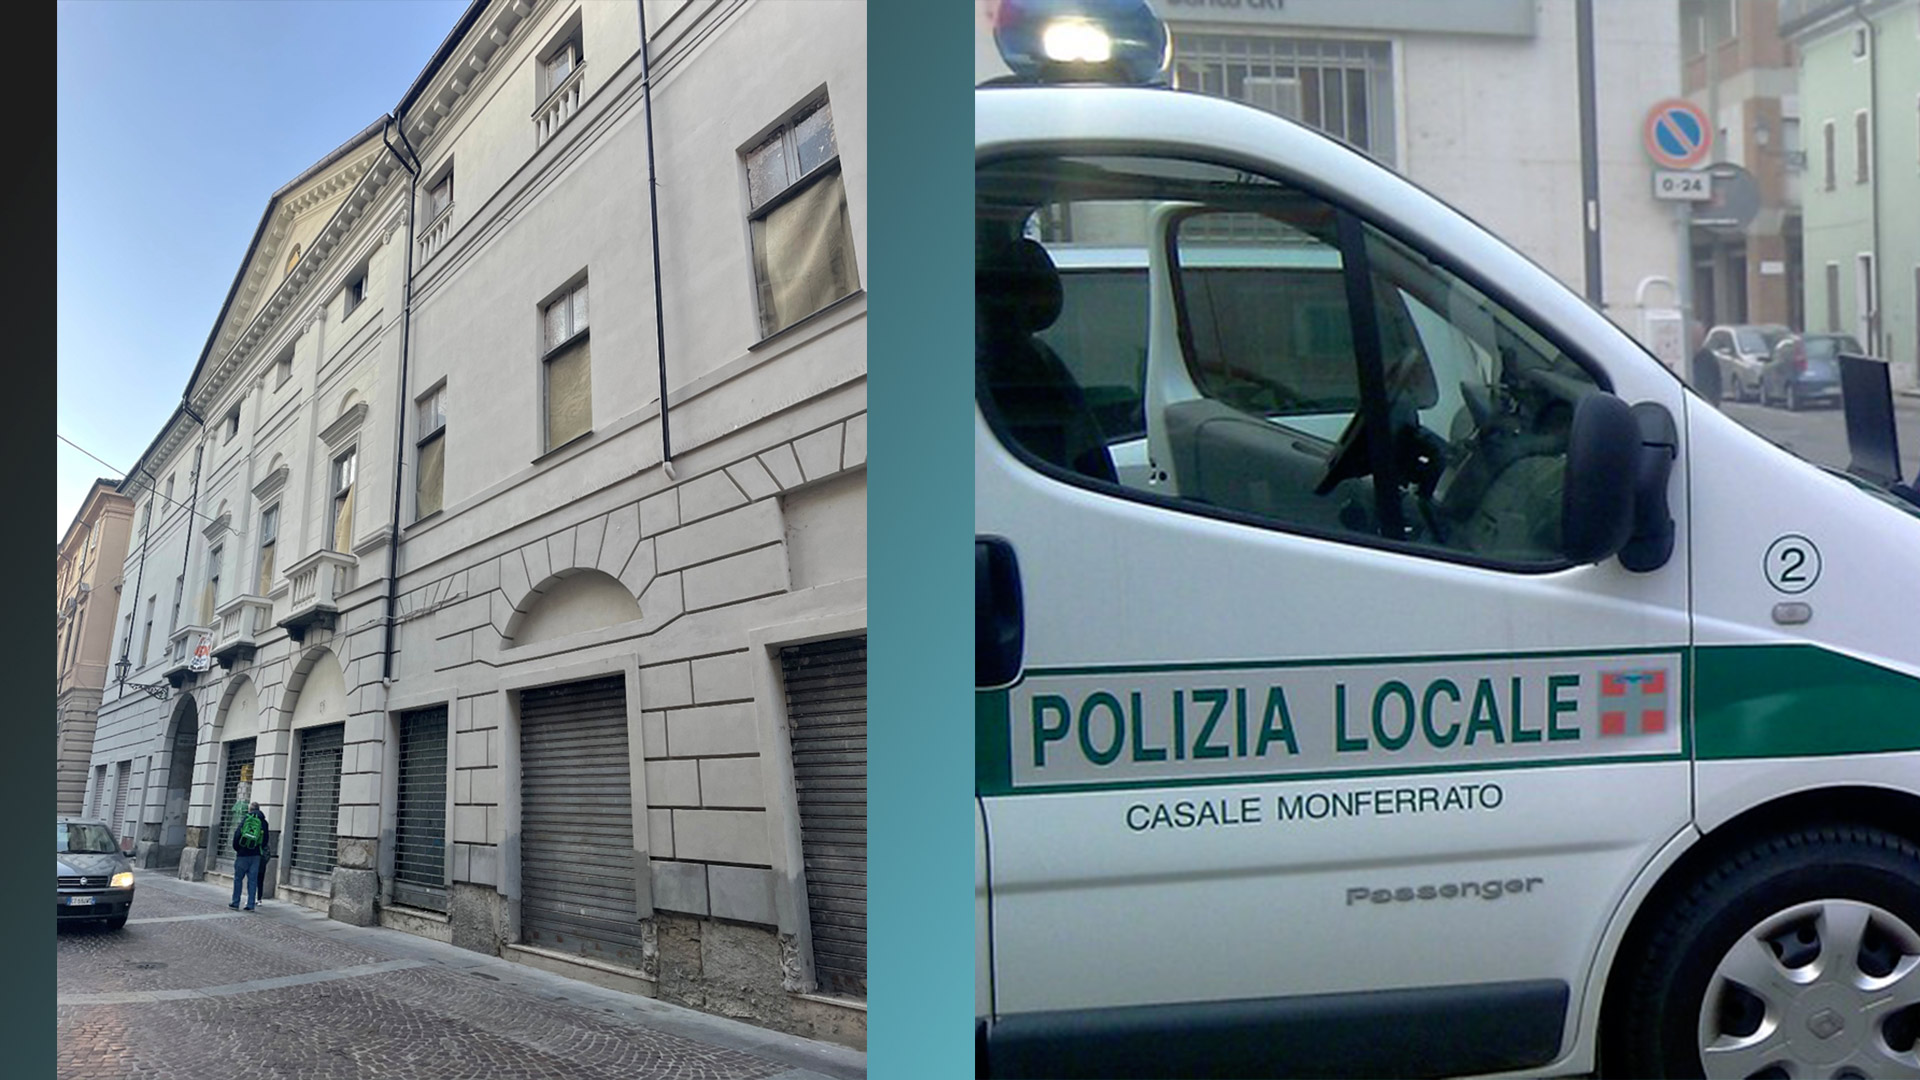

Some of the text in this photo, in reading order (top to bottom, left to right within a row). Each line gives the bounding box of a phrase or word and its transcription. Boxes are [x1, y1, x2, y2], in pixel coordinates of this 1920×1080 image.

[1662, 178, 1703, 192] 0-24
[1780, 547, 1807, 582] 2
[1031, 674, 1581, 768] POLIZIA LOCALE
[1126, 784, 1504, 831] CASALE MONFERRATO
[1346, 877, 1544, 907] Passenger
